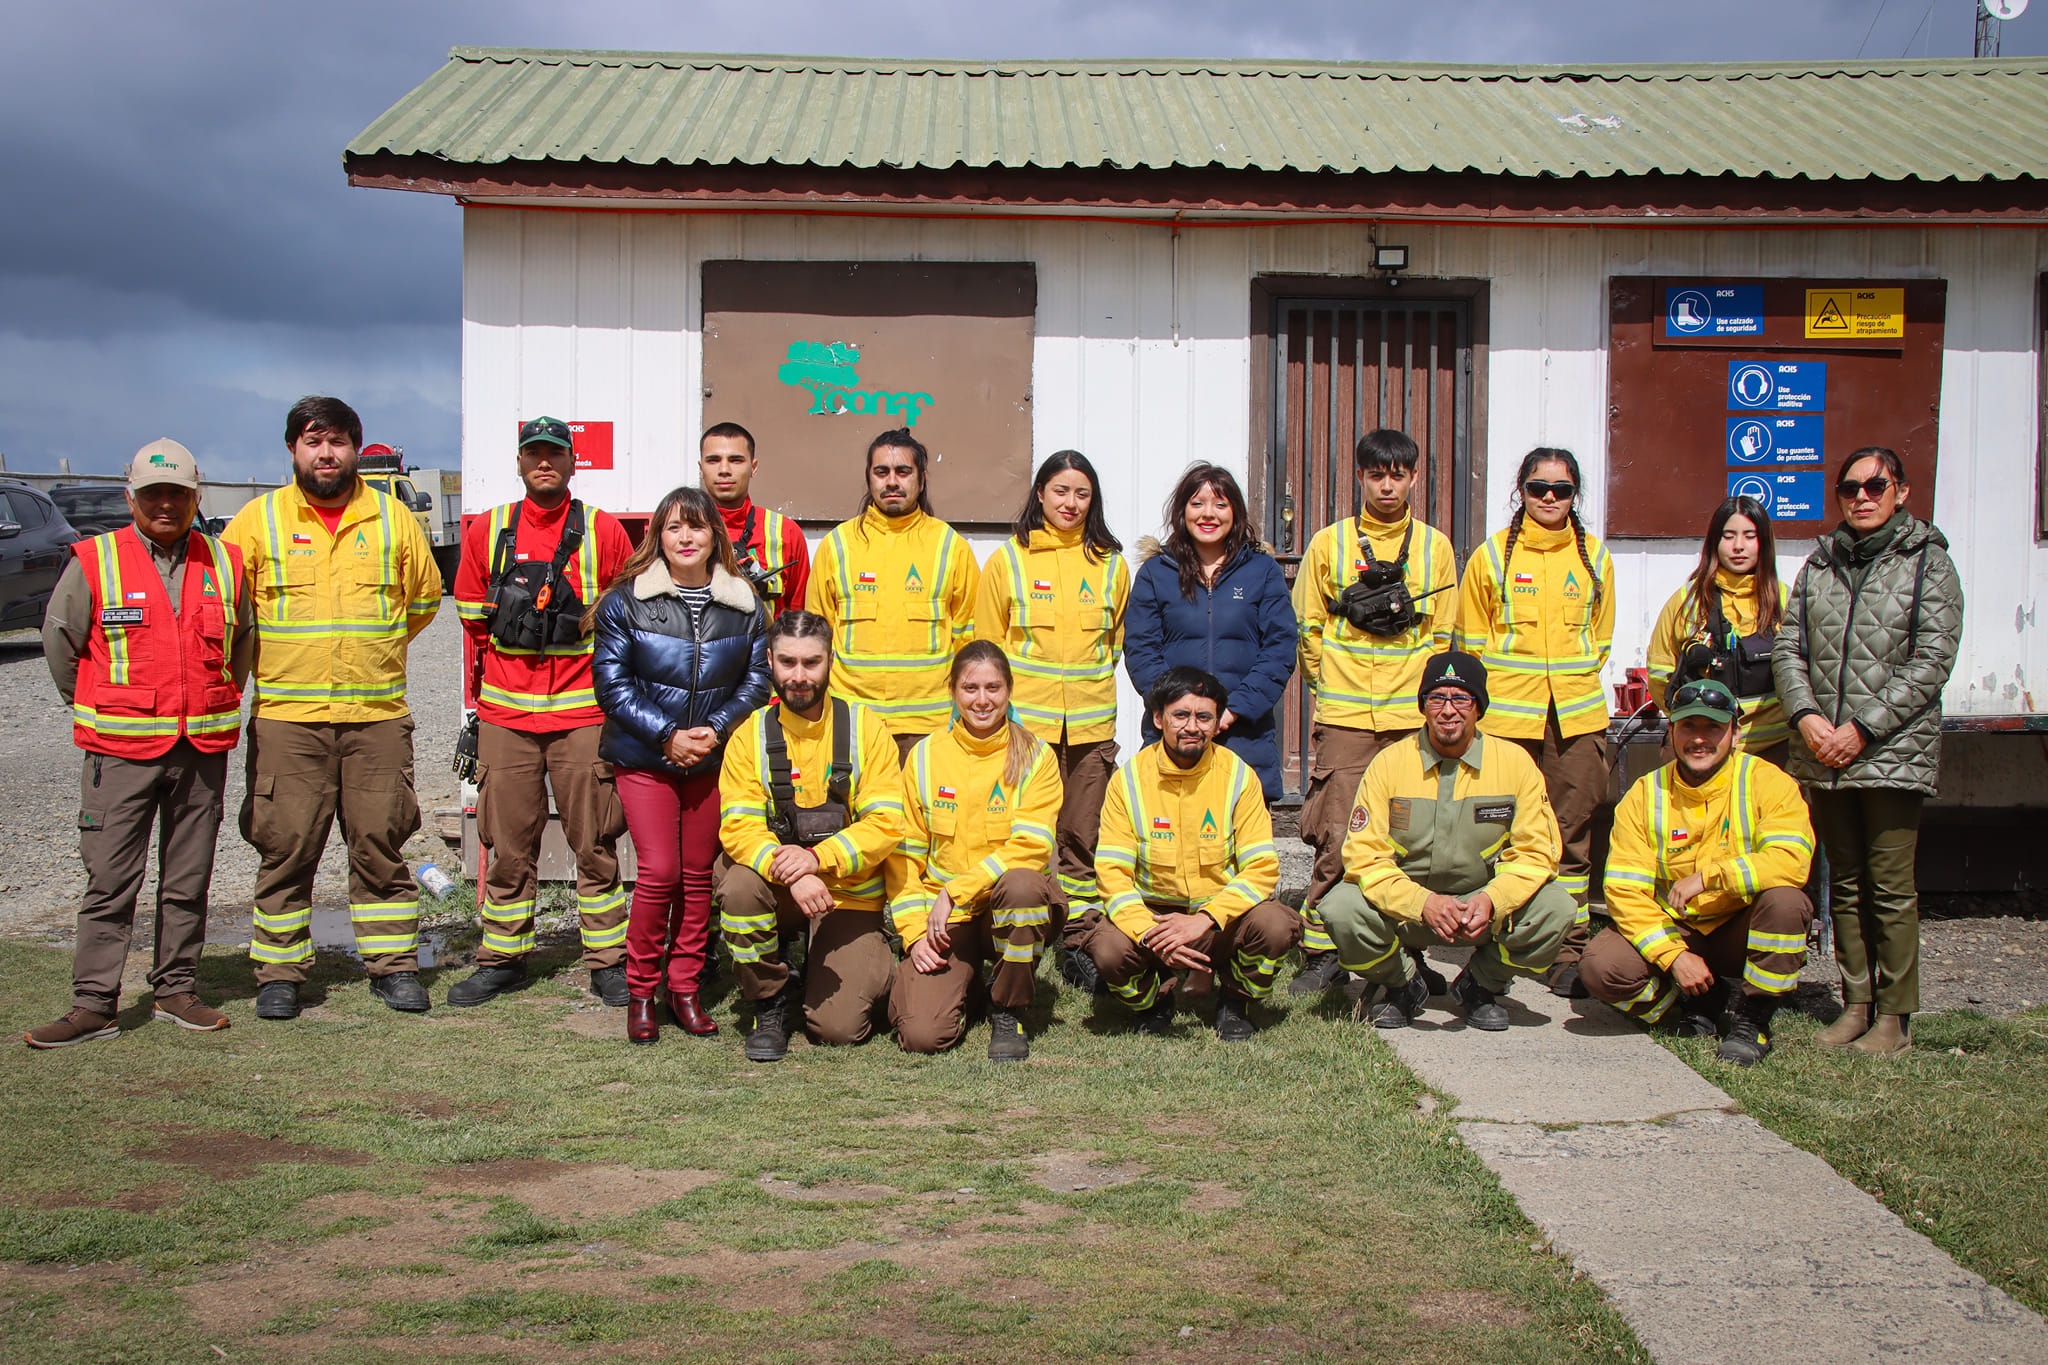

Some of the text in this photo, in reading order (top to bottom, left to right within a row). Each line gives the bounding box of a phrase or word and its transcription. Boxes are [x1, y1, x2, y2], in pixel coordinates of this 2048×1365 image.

[1857, 292, 1875, 300] ACHS
[1729, 317, 1754, 325] calzado
[1726, 324, 1757, 333] seguridad
[1856, 327, 1897, 335] atrapamiento
[1778, 365, 1798, 373] ACHS
[1777, 393, 1811, 402] protección
[1776, 419, 1795, 427] ACHS
[1789, 447, 1815, 455] guantes
[1785, 454, 1819, 463] protección
[1777, 475, 1796, 483] ACHS
[1776, 503, 1810, 511] protección
